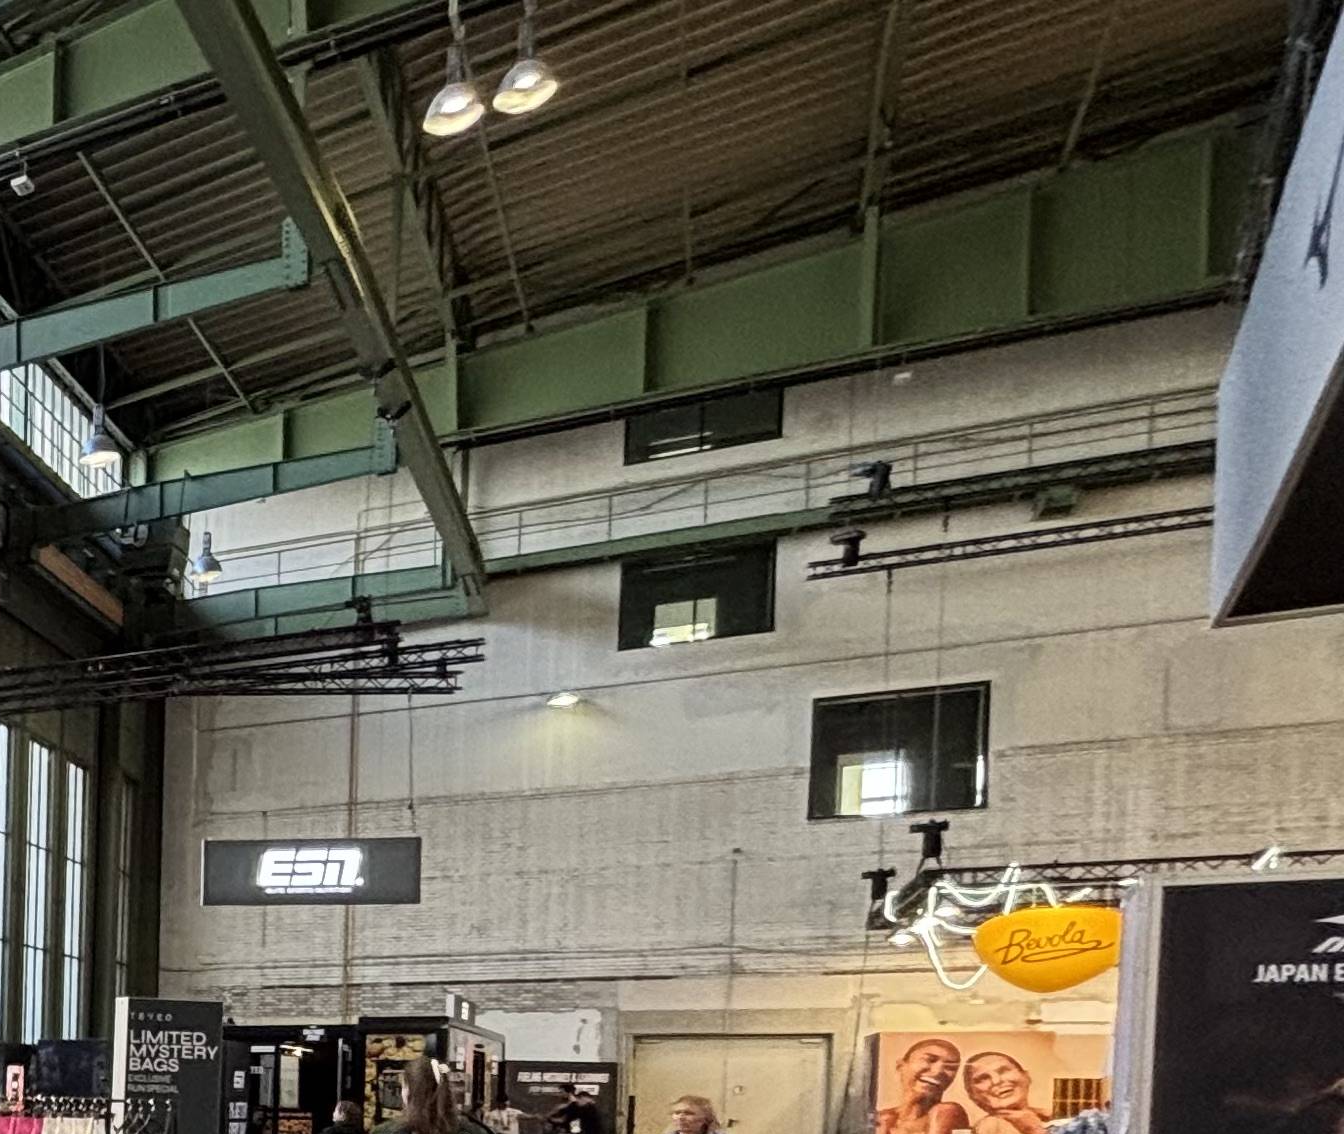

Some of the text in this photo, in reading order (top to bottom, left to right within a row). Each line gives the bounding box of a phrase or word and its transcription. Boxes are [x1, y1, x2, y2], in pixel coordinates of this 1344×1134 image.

[995, 921, 1115, 965] Bevola
[1252, 963, 1329, 983] JAPAN
[129, 1029, 207, 1046] LIMITED
[129, 1044, 219, 1060] MYSTERY
[129, 1058, 180, 1072] BAGS
